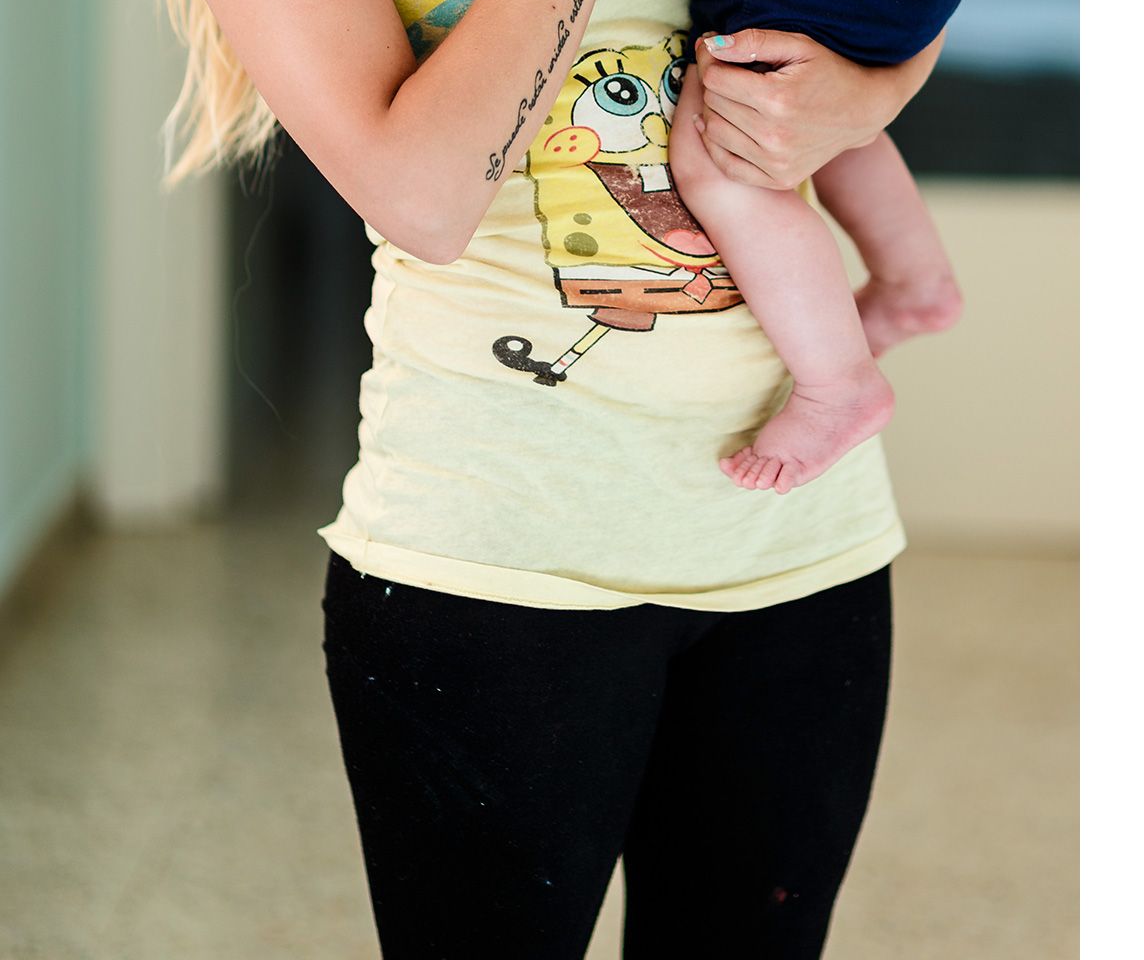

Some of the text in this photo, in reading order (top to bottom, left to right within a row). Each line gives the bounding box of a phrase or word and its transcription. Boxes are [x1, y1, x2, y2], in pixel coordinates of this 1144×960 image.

[486, 153, 501, 180] Se
[494, 98, 526, 181] puede
[548, 20, 570, 73] unidas
